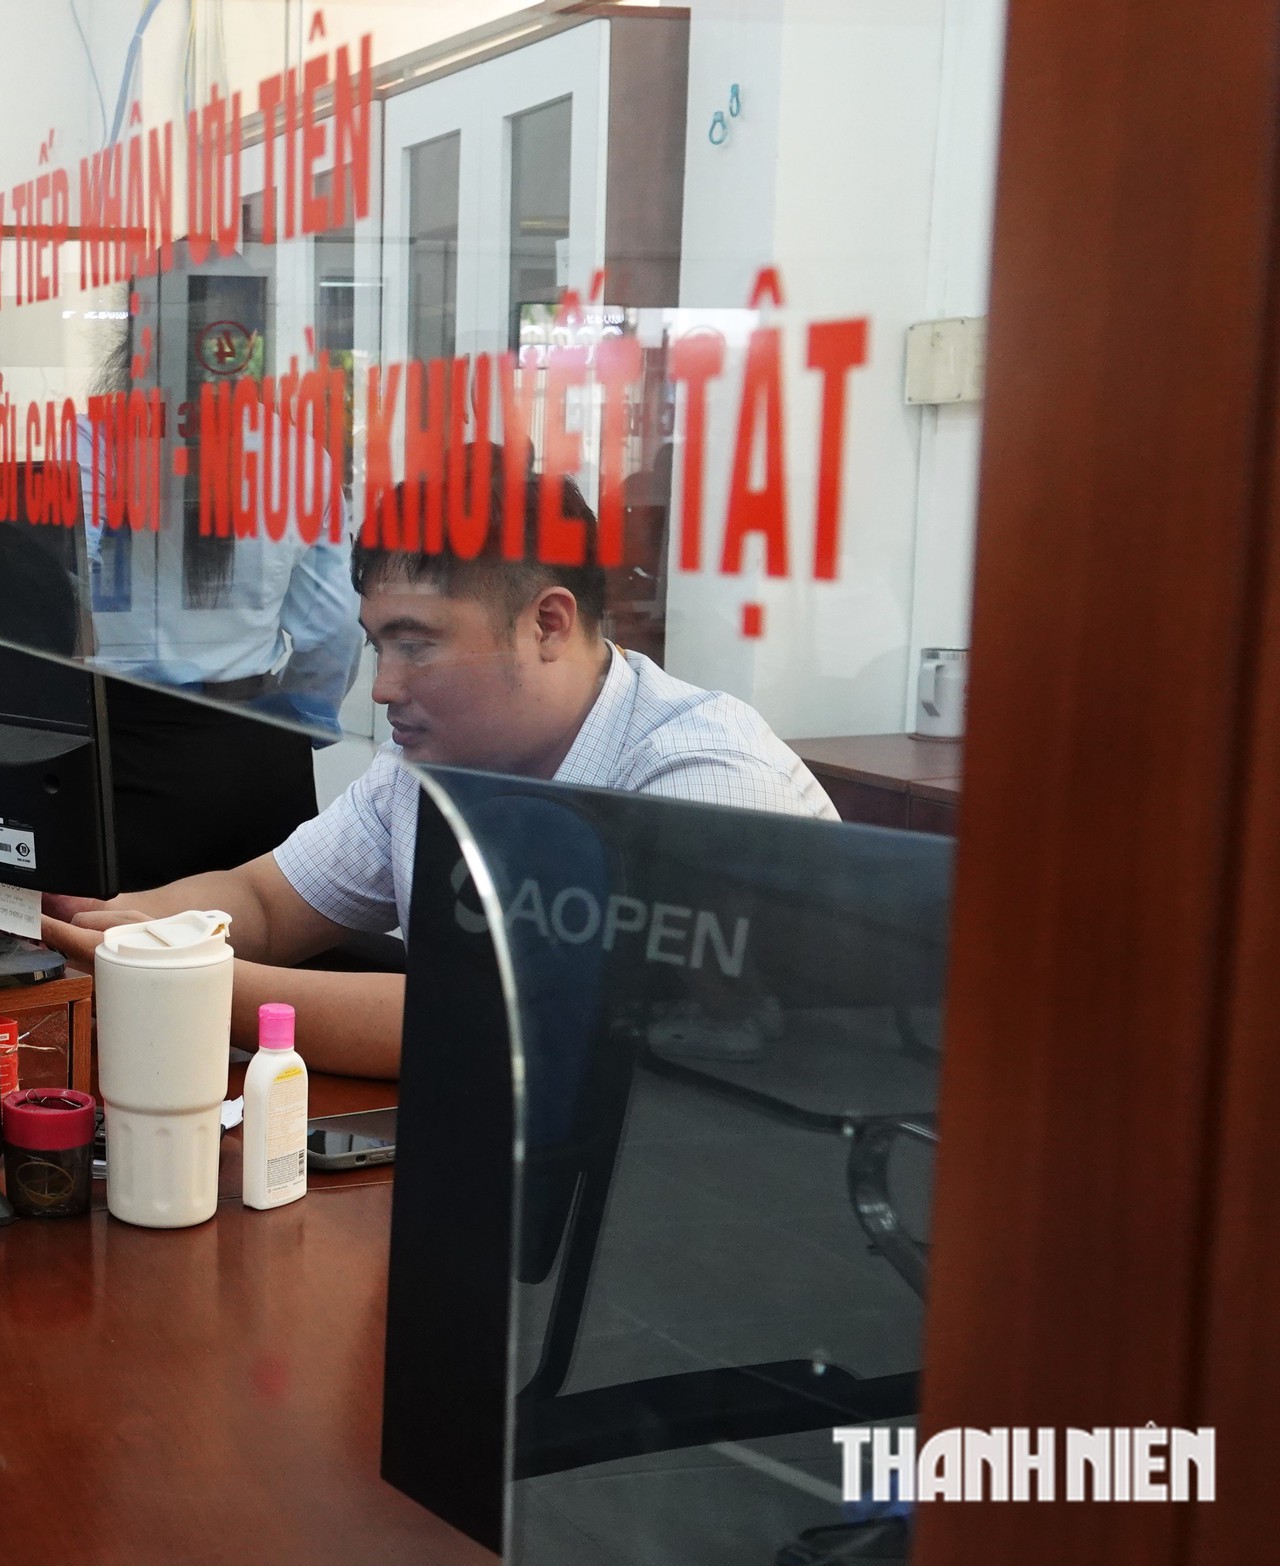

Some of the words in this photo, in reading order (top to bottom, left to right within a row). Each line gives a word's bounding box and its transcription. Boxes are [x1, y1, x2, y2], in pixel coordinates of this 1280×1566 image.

[12, 128, 69, 306] TIẾP
[80, 100, 174, 315] NHẬN
[186, 83, 242, 266] ƯU
[258, 9, 374, 245] TIÊN
[25, 397, 78, 528] CAO
[87, 326, 161, 532] TUỔI
[199, 326, 346, 544] NGƯỜI
[360, 268, 643, 567] KHUYẾT
[668, 265, 870, 638] TẬT
[504, 878, 749, 978] AOPEN
